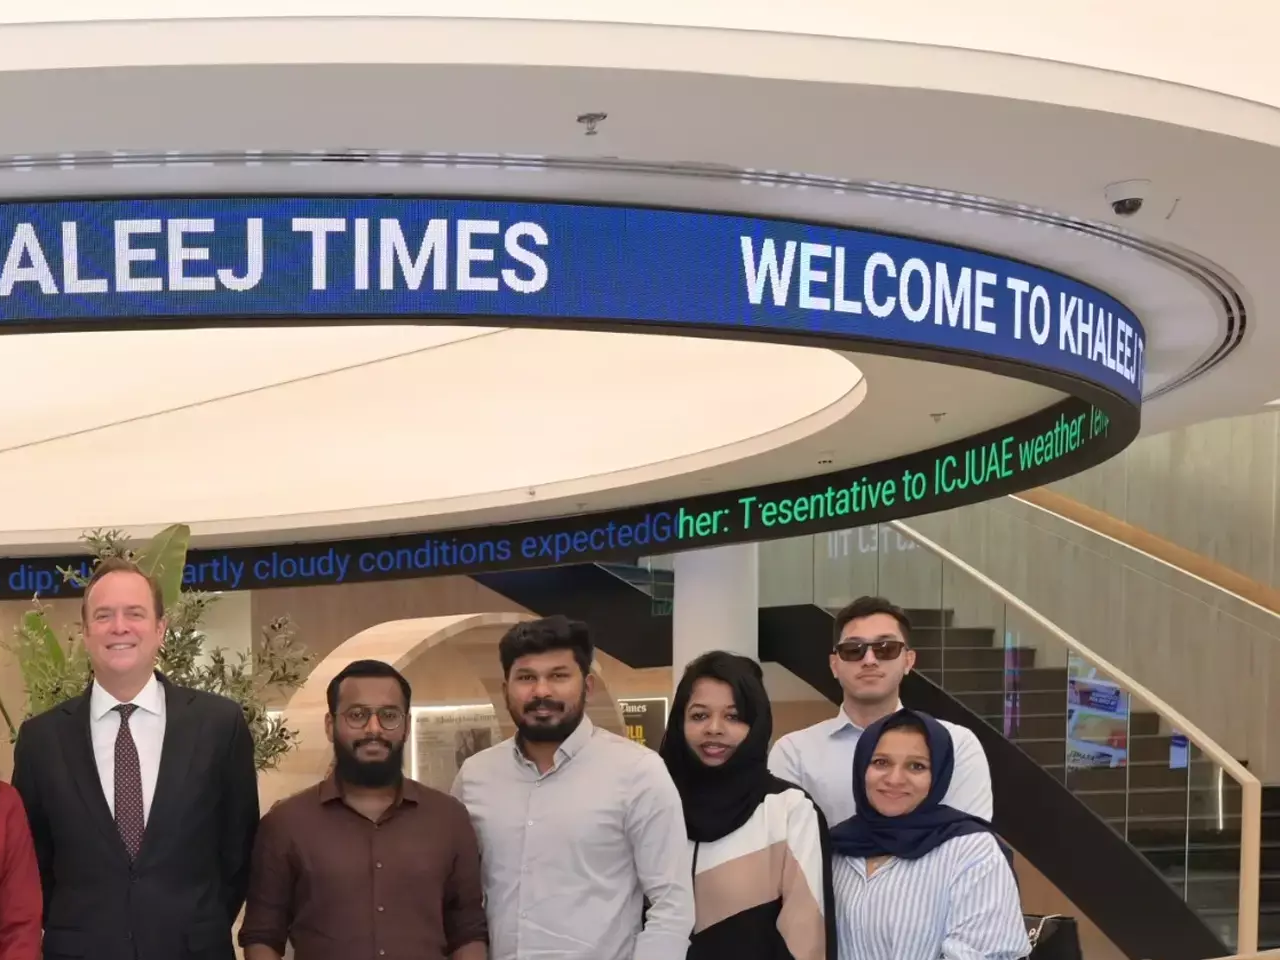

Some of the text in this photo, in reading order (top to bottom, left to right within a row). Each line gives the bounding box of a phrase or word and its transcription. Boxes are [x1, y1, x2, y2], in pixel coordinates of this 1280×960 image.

[292, 218, 550, 294] TIMES
[740, 236, 998, 335] WELCOME
[1007, 277, 1051, 346] TO
[1059, 292, 1138, 384] KHALEEJ
[902, 468, 927, 501] to
[934, 436, 1015, 495] ICJUAE
[8, 564, 60, 594] dip;
[182, 553, 243, 588] artly
[253, 547, 349, 582] cloudy
[358, 538, 511, 573] conditions
